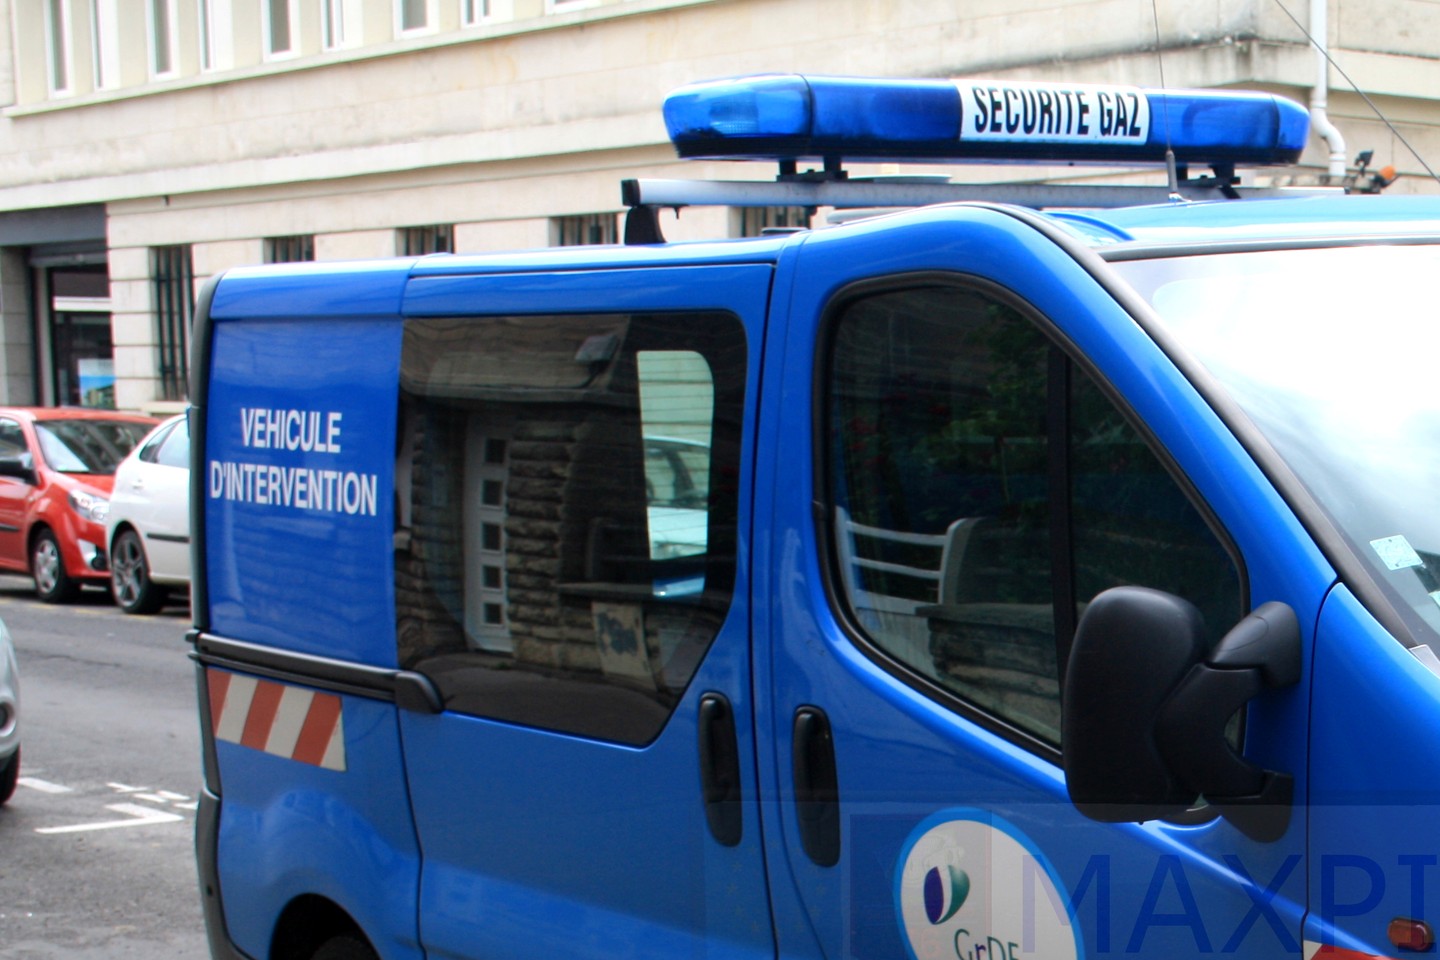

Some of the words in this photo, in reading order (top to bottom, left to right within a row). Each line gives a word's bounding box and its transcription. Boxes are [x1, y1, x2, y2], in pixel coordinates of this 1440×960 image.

[973, 86, 1091, 137] SECURITE
[1098, 91, 1142, 137] GAZ
[241, 407, 342, 453] VEHICULE
[210, 460, 377, 516] D'INTERVENTION
